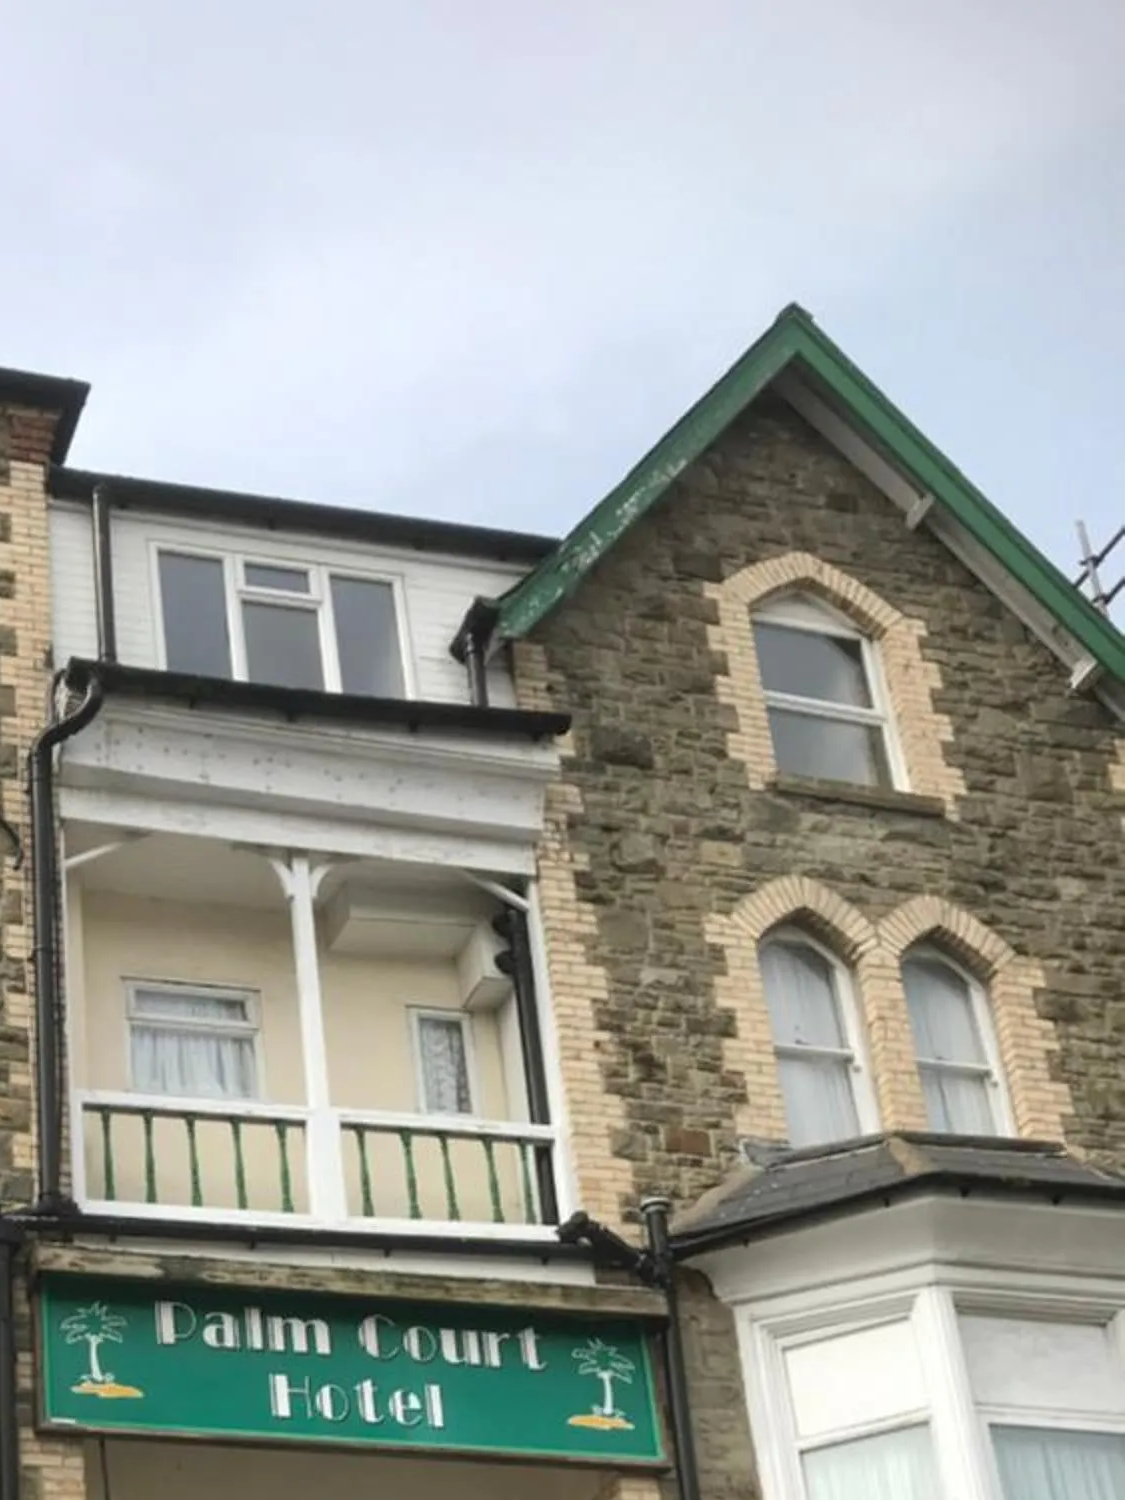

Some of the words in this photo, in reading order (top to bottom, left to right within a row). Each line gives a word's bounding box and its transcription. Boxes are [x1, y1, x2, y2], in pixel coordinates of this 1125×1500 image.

[155, 1301, 332, 1356] Palm
[358, 1314, 547, 1372] Court
[269, 1373, 446, 1428] Hotel
